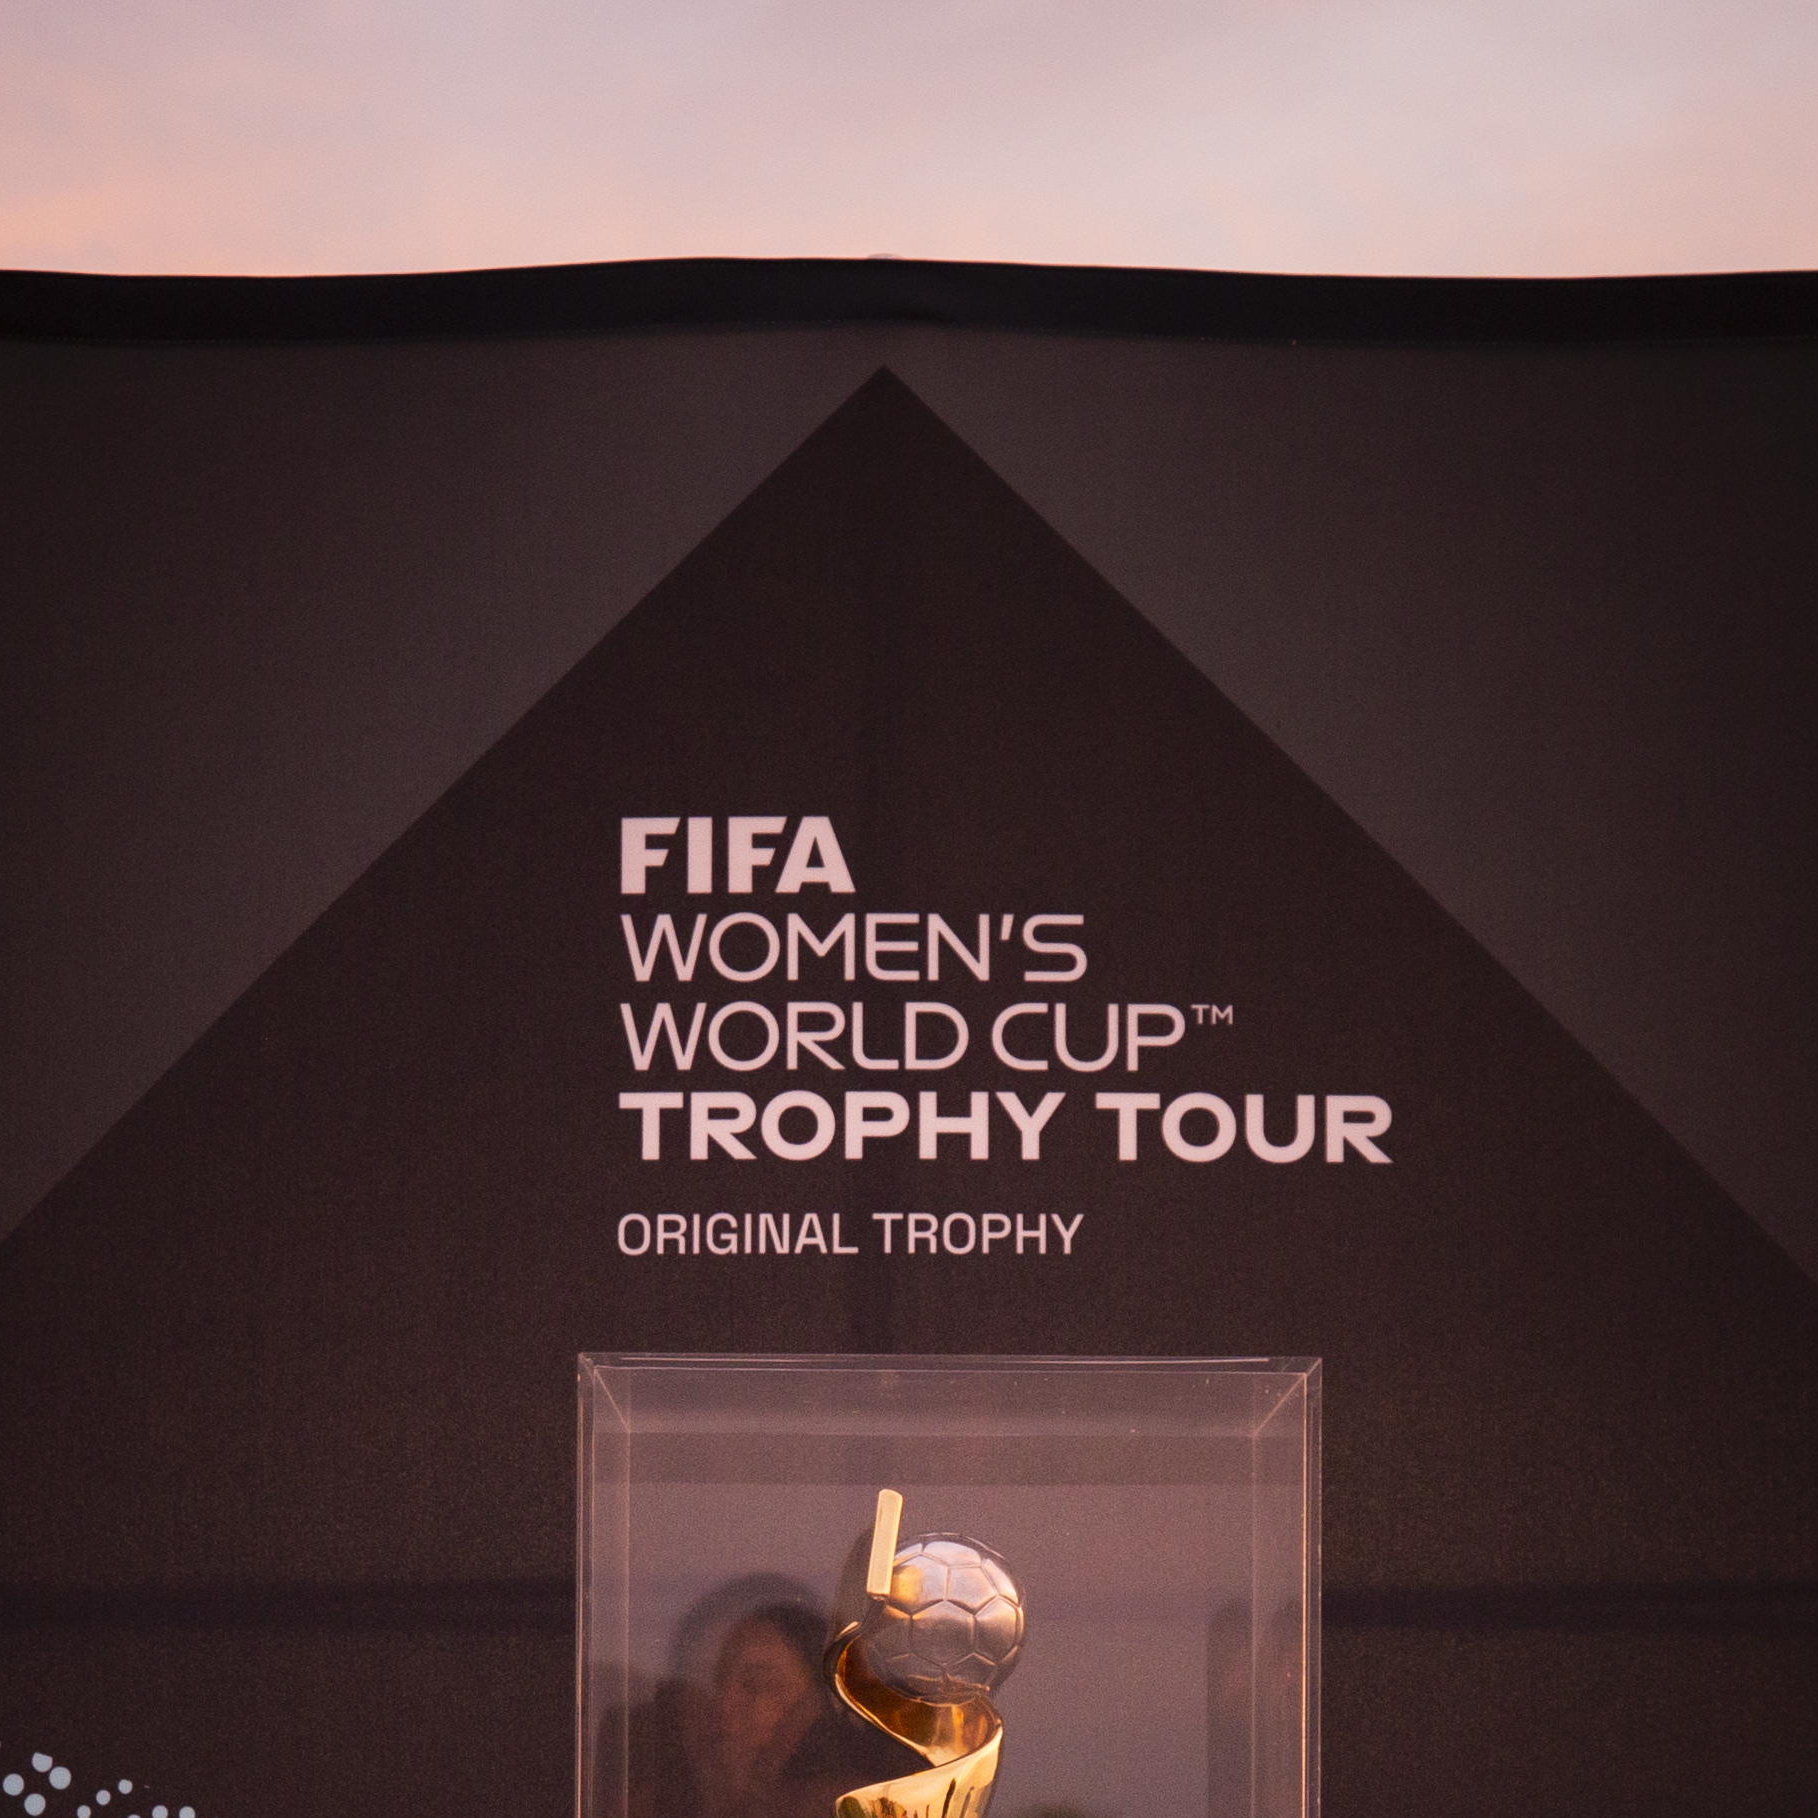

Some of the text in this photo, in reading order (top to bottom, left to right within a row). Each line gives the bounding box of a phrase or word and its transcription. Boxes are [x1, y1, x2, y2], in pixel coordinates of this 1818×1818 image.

[620, 816, 856, 894] FIFA
[620, 912, 1088, 982] WOMEN'S
[620, 1001, 970, 1072] WORLD
[618, 1090, 1392, 1164] TROPHY TOUR
[617, 1212, 1084, 1256] ORIGINAL TROPHY
